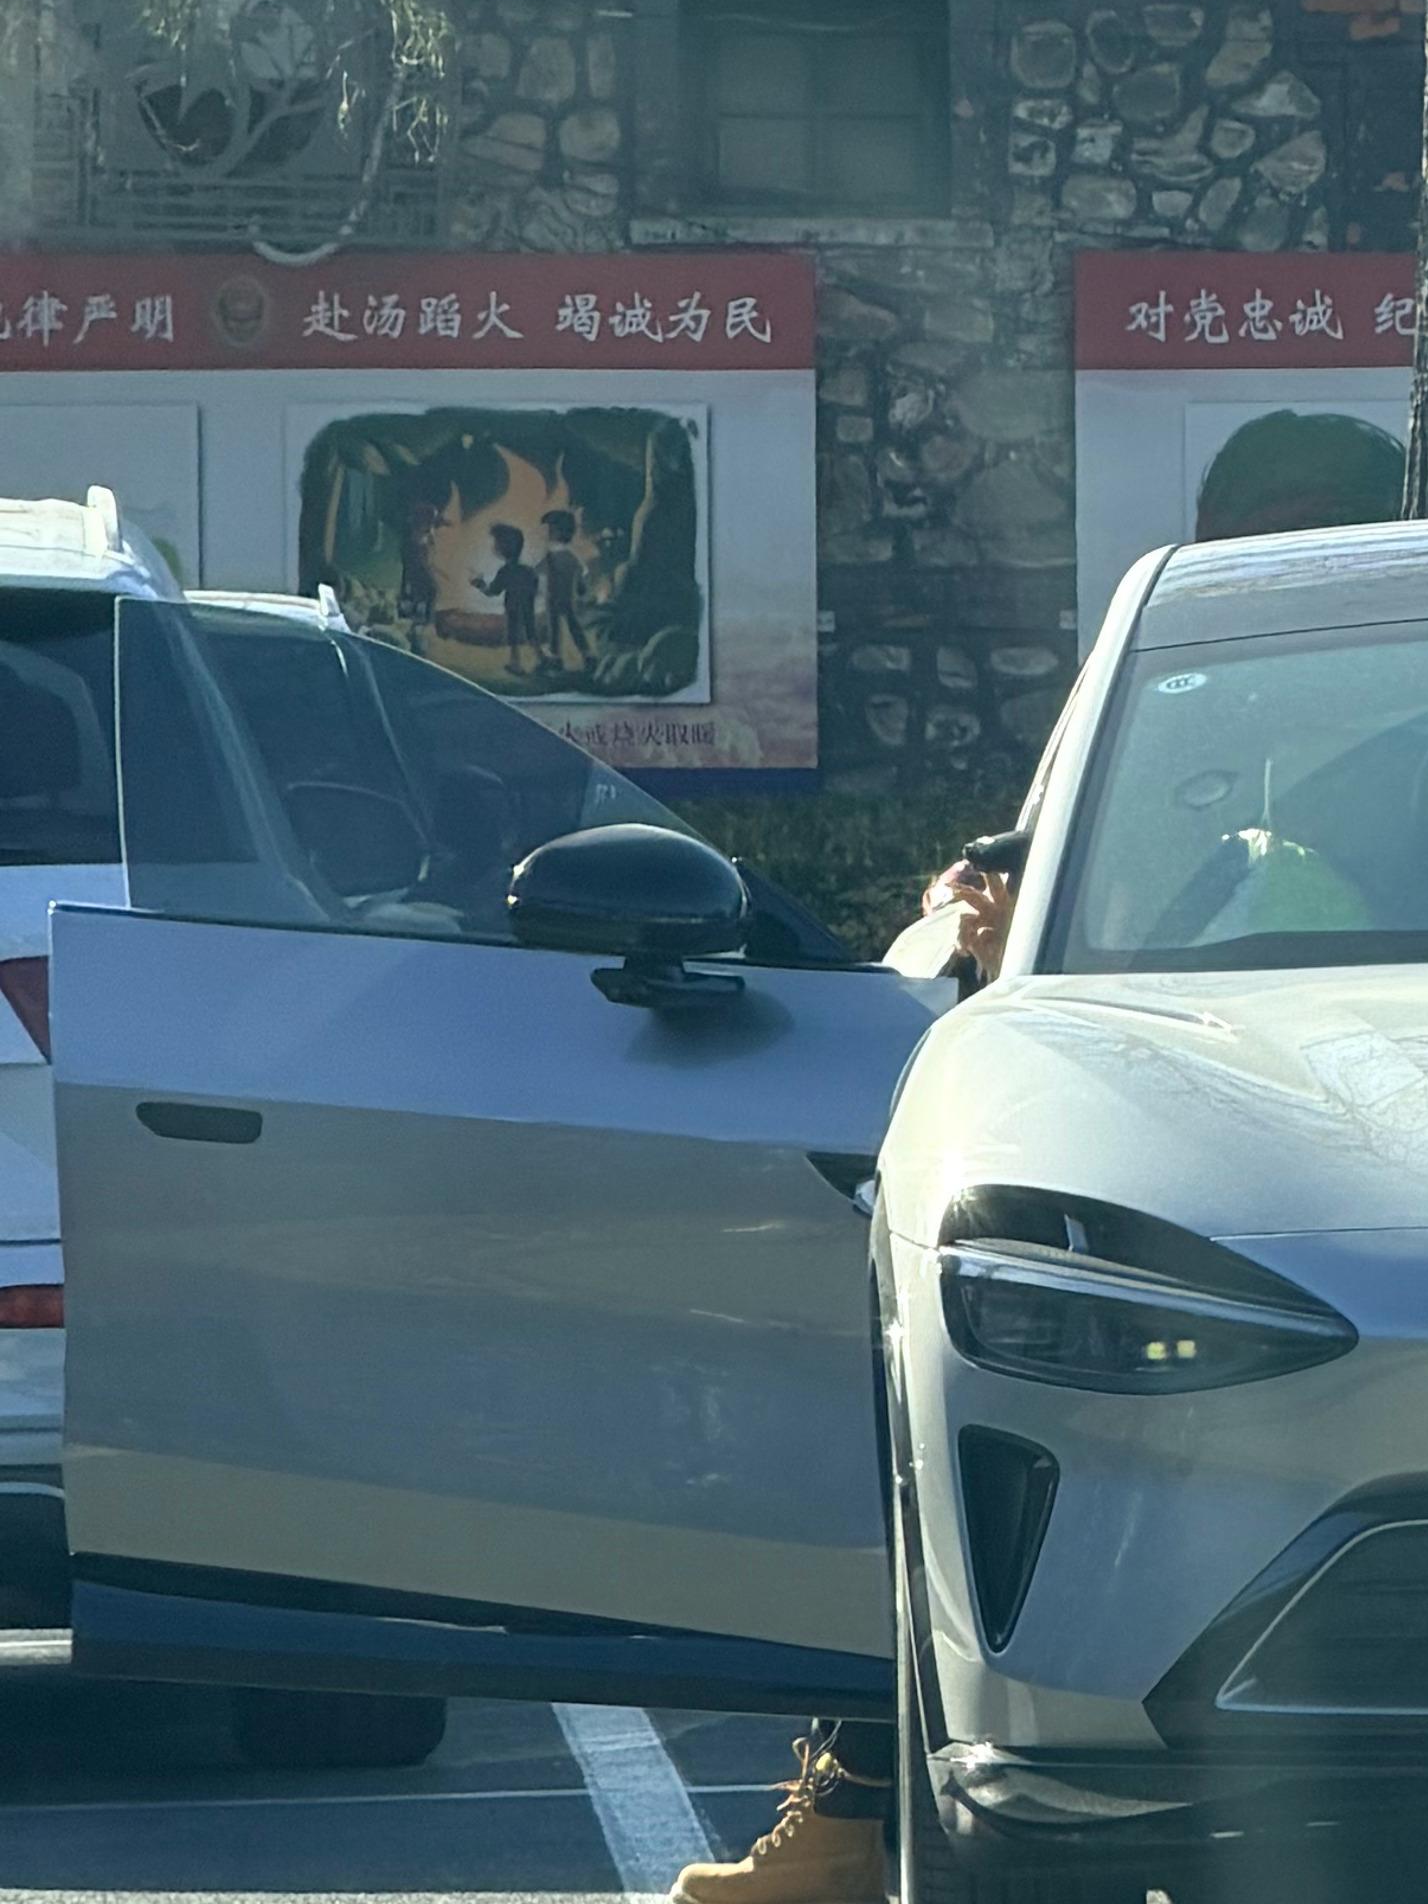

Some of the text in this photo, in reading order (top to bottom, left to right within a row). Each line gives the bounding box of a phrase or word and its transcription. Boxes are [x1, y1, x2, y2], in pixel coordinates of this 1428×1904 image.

[302, 289, 772, 344] 赴汤蹈火 竭诚为民
[1125, 288, 1344, 344] 对党忠诚
